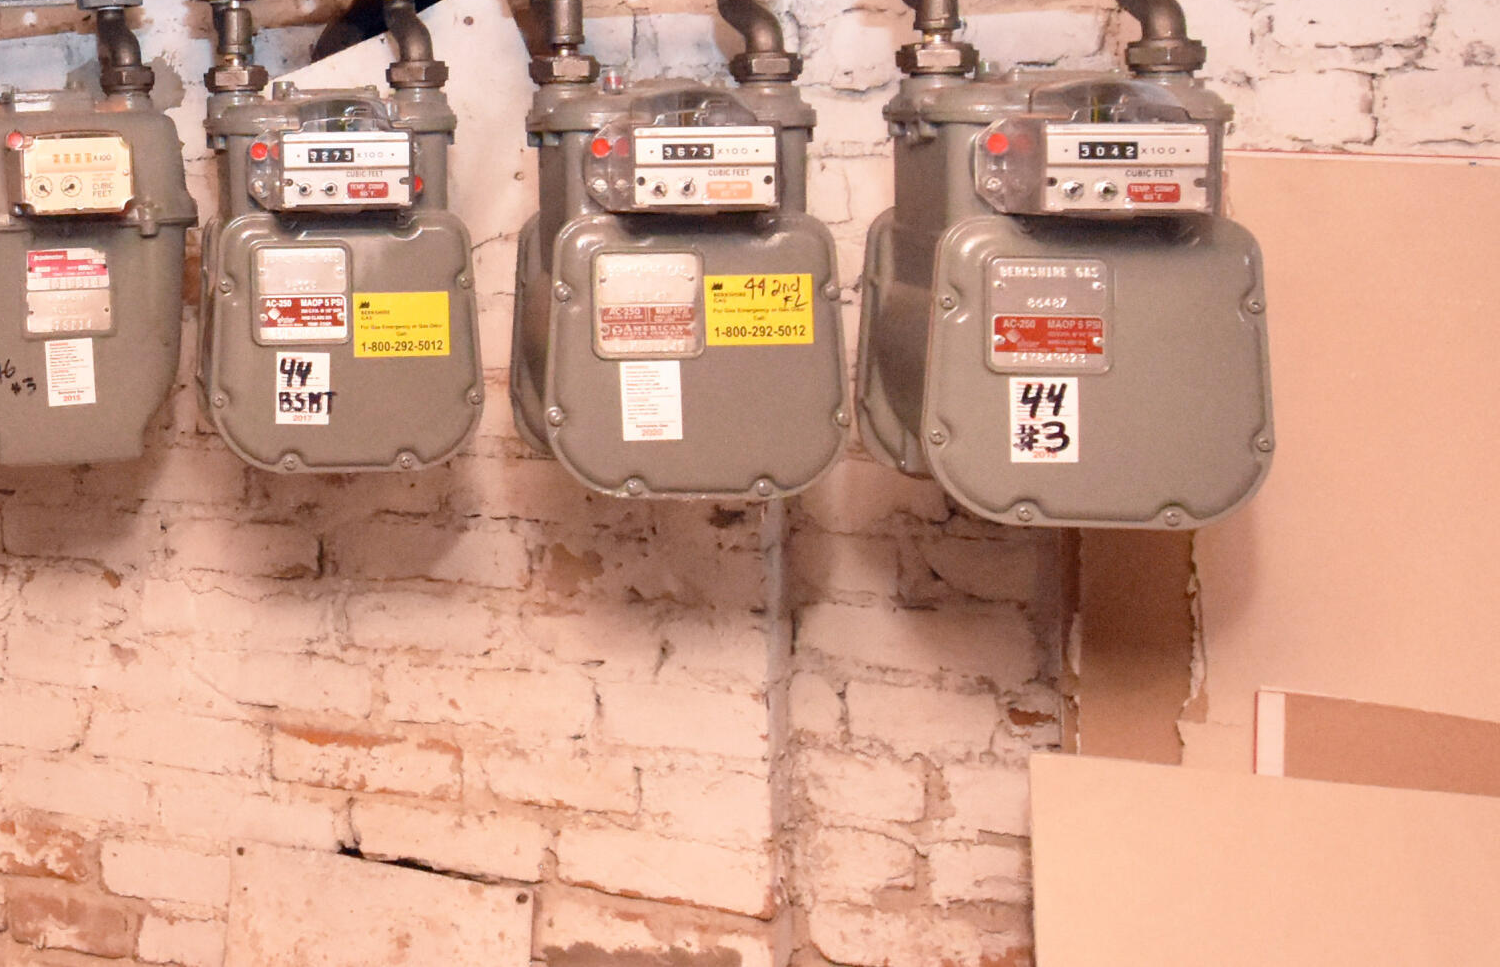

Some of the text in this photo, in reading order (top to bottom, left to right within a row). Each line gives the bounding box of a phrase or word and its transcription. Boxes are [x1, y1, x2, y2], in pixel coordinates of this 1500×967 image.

[665, 147, 711, 157] 3673
[1080, 146, 1135, 157] 3042
[1125, 169, 1174, 177] CUBIC FEET
[1075, 266, 1100, 278] GAS
[744, 276, 800, 300] 44 2nd
[301, 299, 324, 307] MAOP
[1047, 319, 1076, 329] MAOP
[715, 325, 806, 338] 1-800-292-5012
[361, 340, 443, 352] 1-800-292-5012
[280, 358, 312, 388] 44
[279, 391, 337, 415] BSMT
[1021, 383, 1068, 419] 44
[1013, 421, 1071, 453] #3
